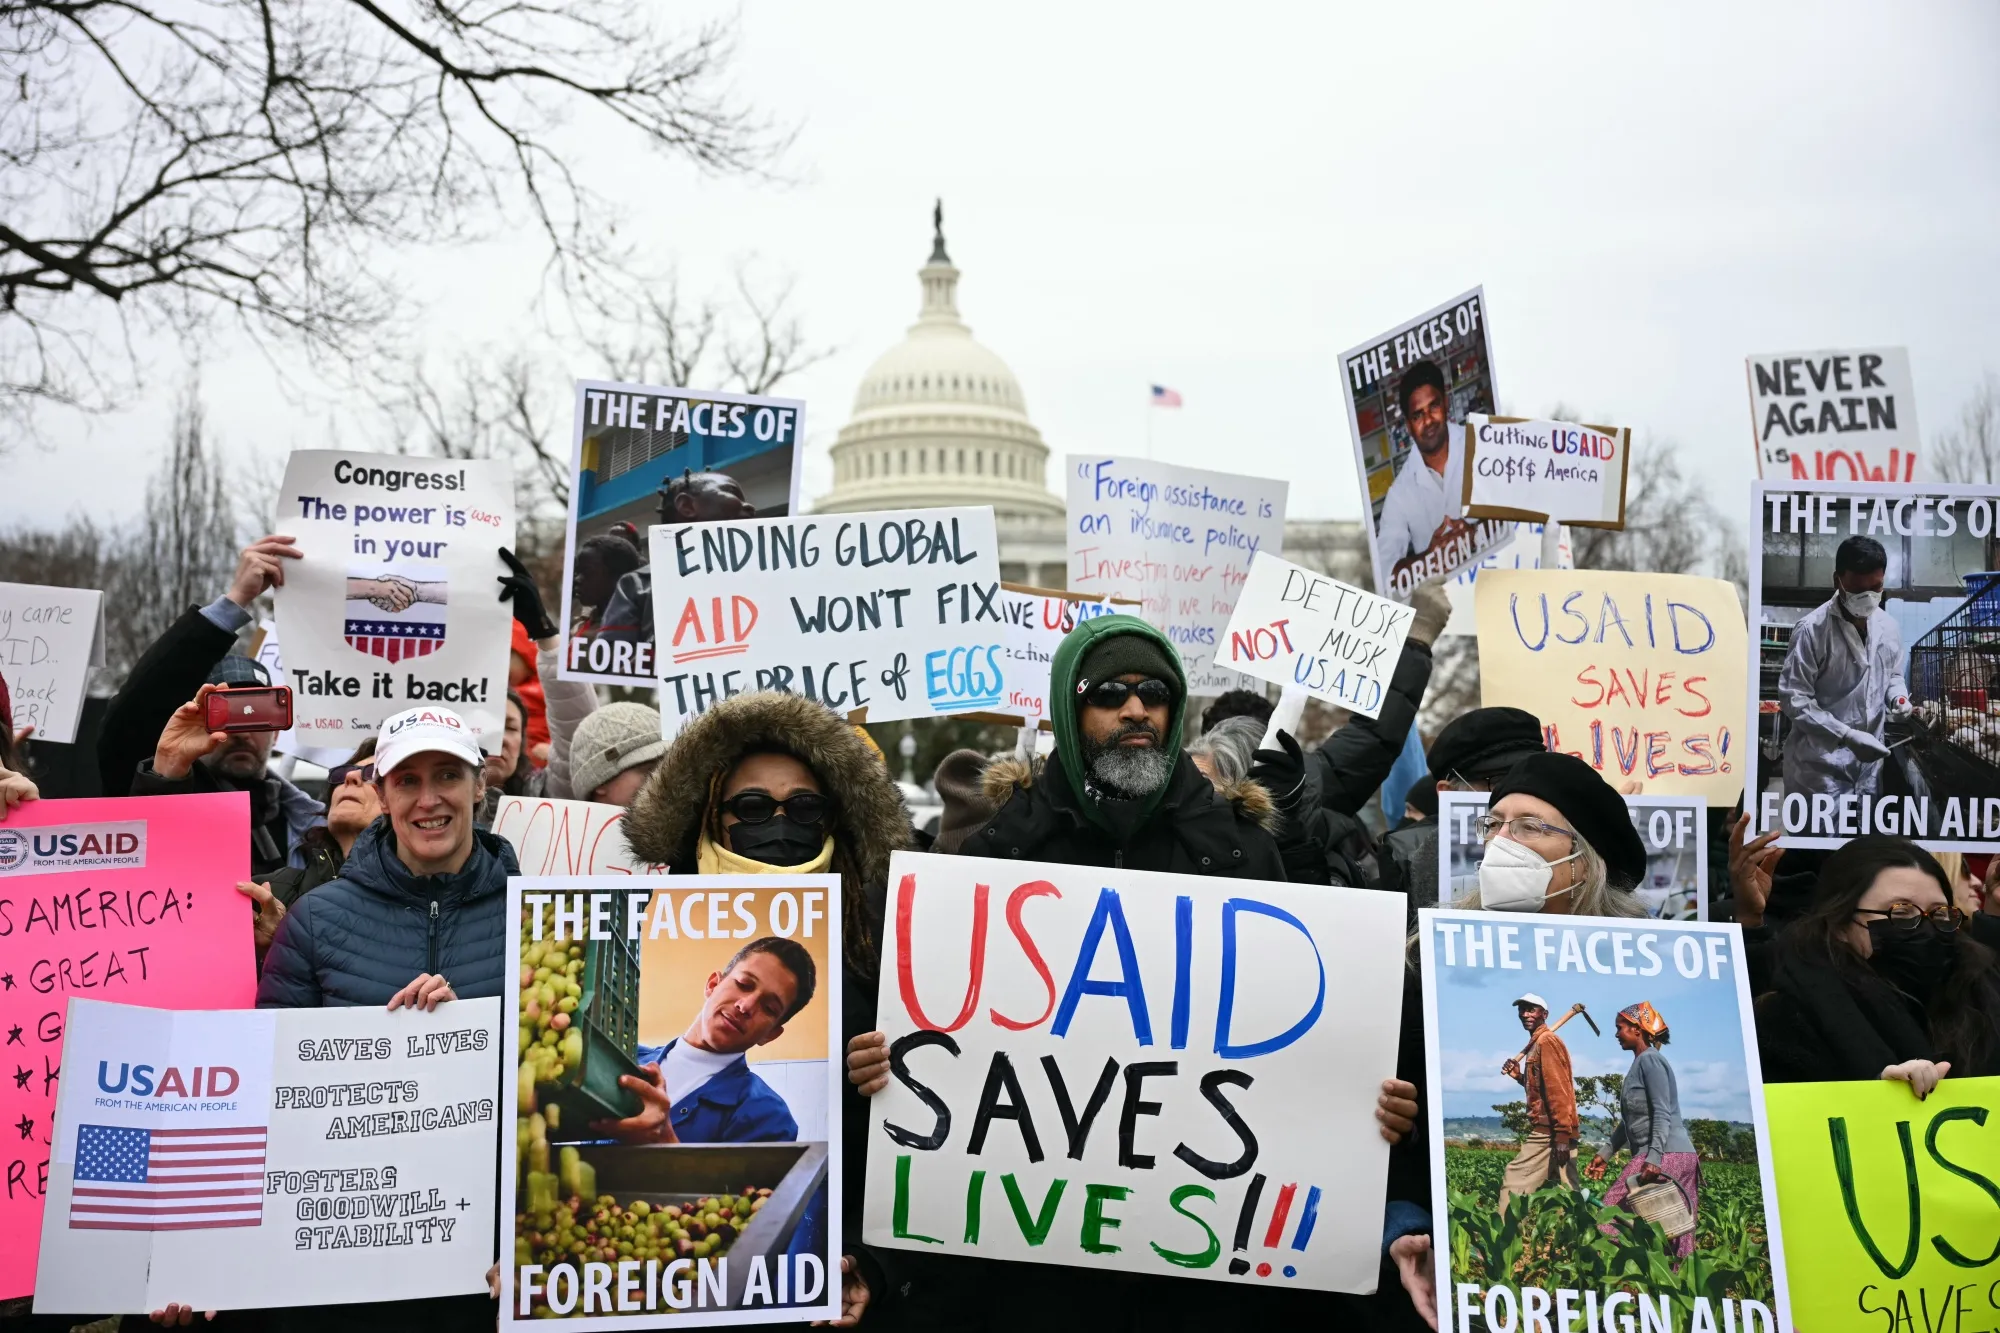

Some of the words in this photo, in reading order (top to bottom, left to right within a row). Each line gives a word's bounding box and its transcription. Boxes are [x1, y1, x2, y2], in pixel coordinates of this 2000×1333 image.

[1349, 345, 1392, 390] THE
[1395, 313, 1453, 368] FACES
[1456, 299, 1480, 336] OF
[1755, 354, 1886, 396] NEVER
[587, 391, 647, 429] THE
[656, 398, 746, 438] FACES
[754, 408, 794, 442] OF
[1763, 395, 1897, 441] AGAIN
[1552, 430, 1614, 460] USAID
[335, 460, 465, 491] Congress!
[299, 496, 346, 520] The
[355, 505, 436, 526] power
[445, 505, 466, 527] is
[1165, 485, 1246, 516] assistance
[1258, 500, 1272, 518] is
[1766, 495, 1837, 534] THE
[1850, 497, 1957, 537] FACES
[1080, 513, 1111, 535] an
[355, 534, 376, 553] in
[383, 539, 447, 562] your
[675, 524, 820, 577] ENDING
[835, 517, 978, 568] GLOBAL
[1385, 531, 1472, 600] FOREIGN
[1474, 519, 1508, 552] AID
[1173, 565, 1213, 582] over
[22, 606, 72, 624] came
[672, 595, 759, 647] AID
[789, 587, 911, 634] WON'T
[937, 581, 1001, 625] FIX
[1179, 600, 1201, 615] we
[1281, 569, 1409, 647] DETUSK
[1510, 590, 1715, 654] USAID
[1169, 621, 1214, 645] makes
[1232, 619, 1293, 661] NOT
[1319, 628, 1387, 676] MUSK
[570, 636, 658, 673] FORE
[15, 677, 57, 704] back
[292, 669, 360, 697] Take
[373, 672, 393, 699] it
[407, 674, 488, 702] back!
[756, 660, 870, 707] PRICE
[880, 652, 910, 701] of
[924, 645, 1001, 699] EGGS
[1187, 670, 1231, 688] Graham
[1572, 664, 1712, 717] SAVES
[352, 718, 375, 730] Save
[390, 712, 460, 734] USAID
[1542, 718, 1732, 778] LIVES!
[1649, 810, 1693, 848] OF
[1760, 791, 1928, 837] FOREIGN
[34, 833, 138, 856] USAID
[25, 888, 193, 935] AMERICA:
[525, 894, 612, 941] THE
[628, 892, 756, 940] FACES
[769, 892, 823, 938] OF
[30, 947, 149, 993] GREAT
[896, 873, 1325, 1059] USAID
[1436, 922, 1522, 969] THE
[1534, 927, 1663, 977] FACES
[1673, 935, 1727, 980] OF
[298, 1038, 391, 1061] SAVES
[407, 1029, 489, 1058] LIVES
[98, 1061, 239, 1097] USAID
[275, 1081, 418, 1109] PROTECTS
[95, 1098, 121, 1108] FROM
[124, 1100, 142, 1109] THE
[145, 1102, 197, 1112] AMERICAN
[201, 1102, 237, 1111] PEOPLE
[326, 1099, 493, 1139] AMERICANS
[883, 1029, 1258, 1180] SAVES
[267, 1166, 397, 1194] FOSTERS
[297, 1188, 445, 1220] GOODWILL
[893, 1154, 1322, 1277] LIVES!!!
[295, 1217, 456, 1250] STABILITY
[519, 1256, 728, 1316] FOREIGN
[742, 1253, 825, 1306] AID
[1457, 1283, 1672, 1333] FOREIGN
[1691, 1296, 1775, 1333] AID
